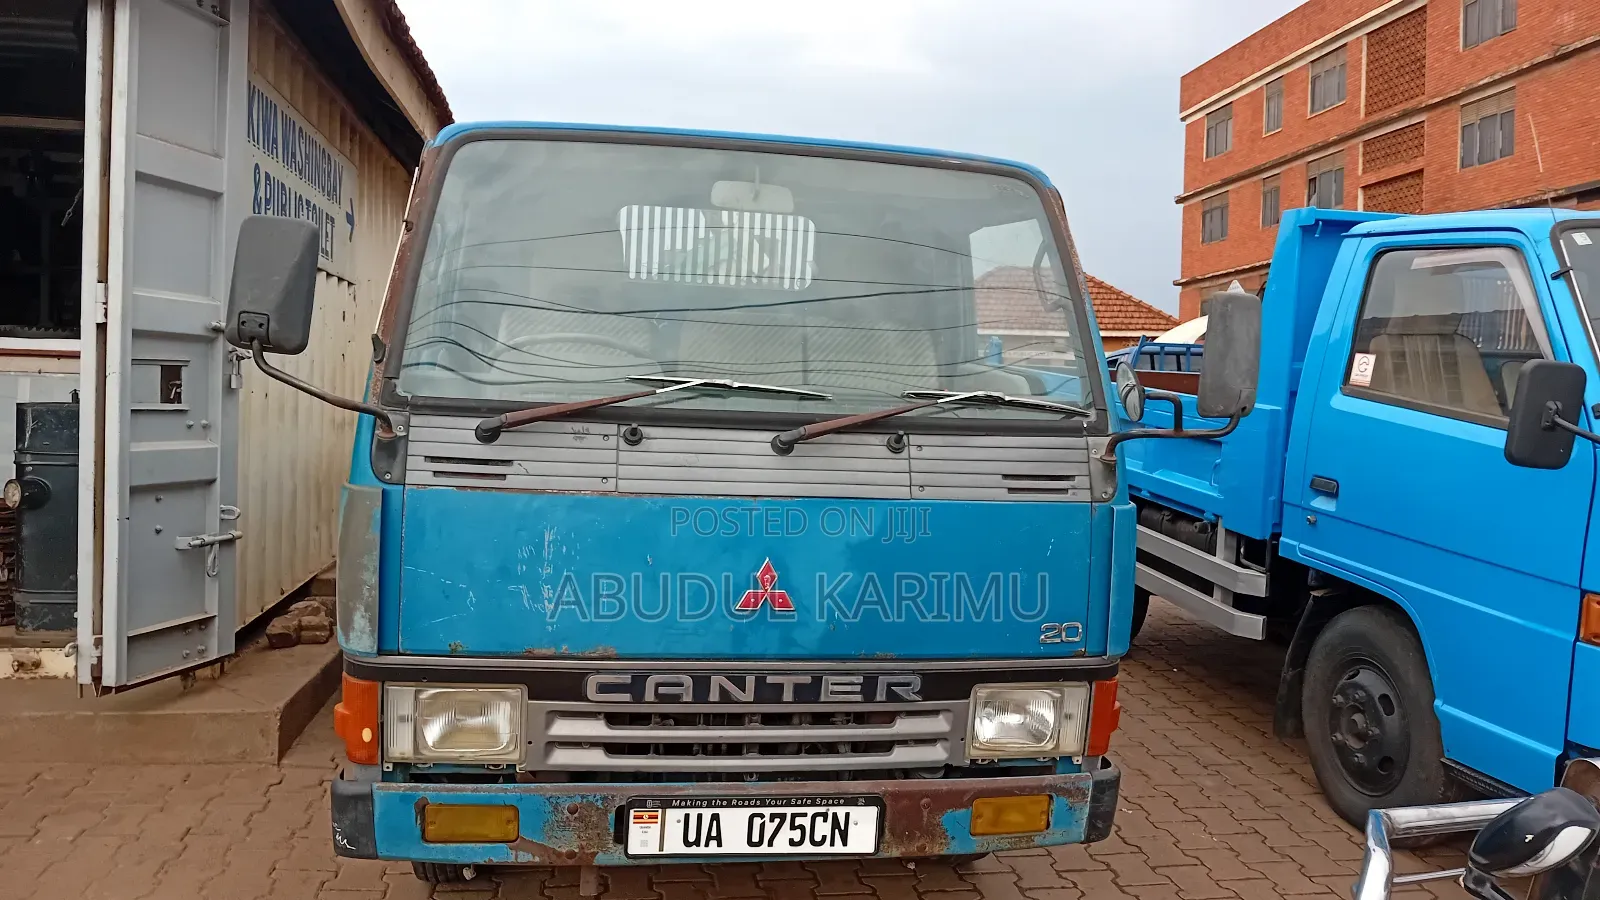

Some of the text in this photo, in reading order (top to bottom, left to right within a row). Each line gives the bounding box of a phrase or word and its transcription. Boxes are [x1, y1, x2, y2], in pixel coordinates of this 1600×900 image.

[247, 80, 279, 163] KIWA
[252, 162, 262, 215] &
[1039, 621, 1083, 643] 20
[585, 673, 923, 702] CANTER
[671, 799, 708, 808] Making
[711, 798, 728, 807] the
[731, 798, 761, 806] Roads
[765, 798, 788, 806] Your
[790, 797, 812, 805] Safe
[815, 797, 845, 806] Space
[682, 811, 851, 848] UA 075CN
